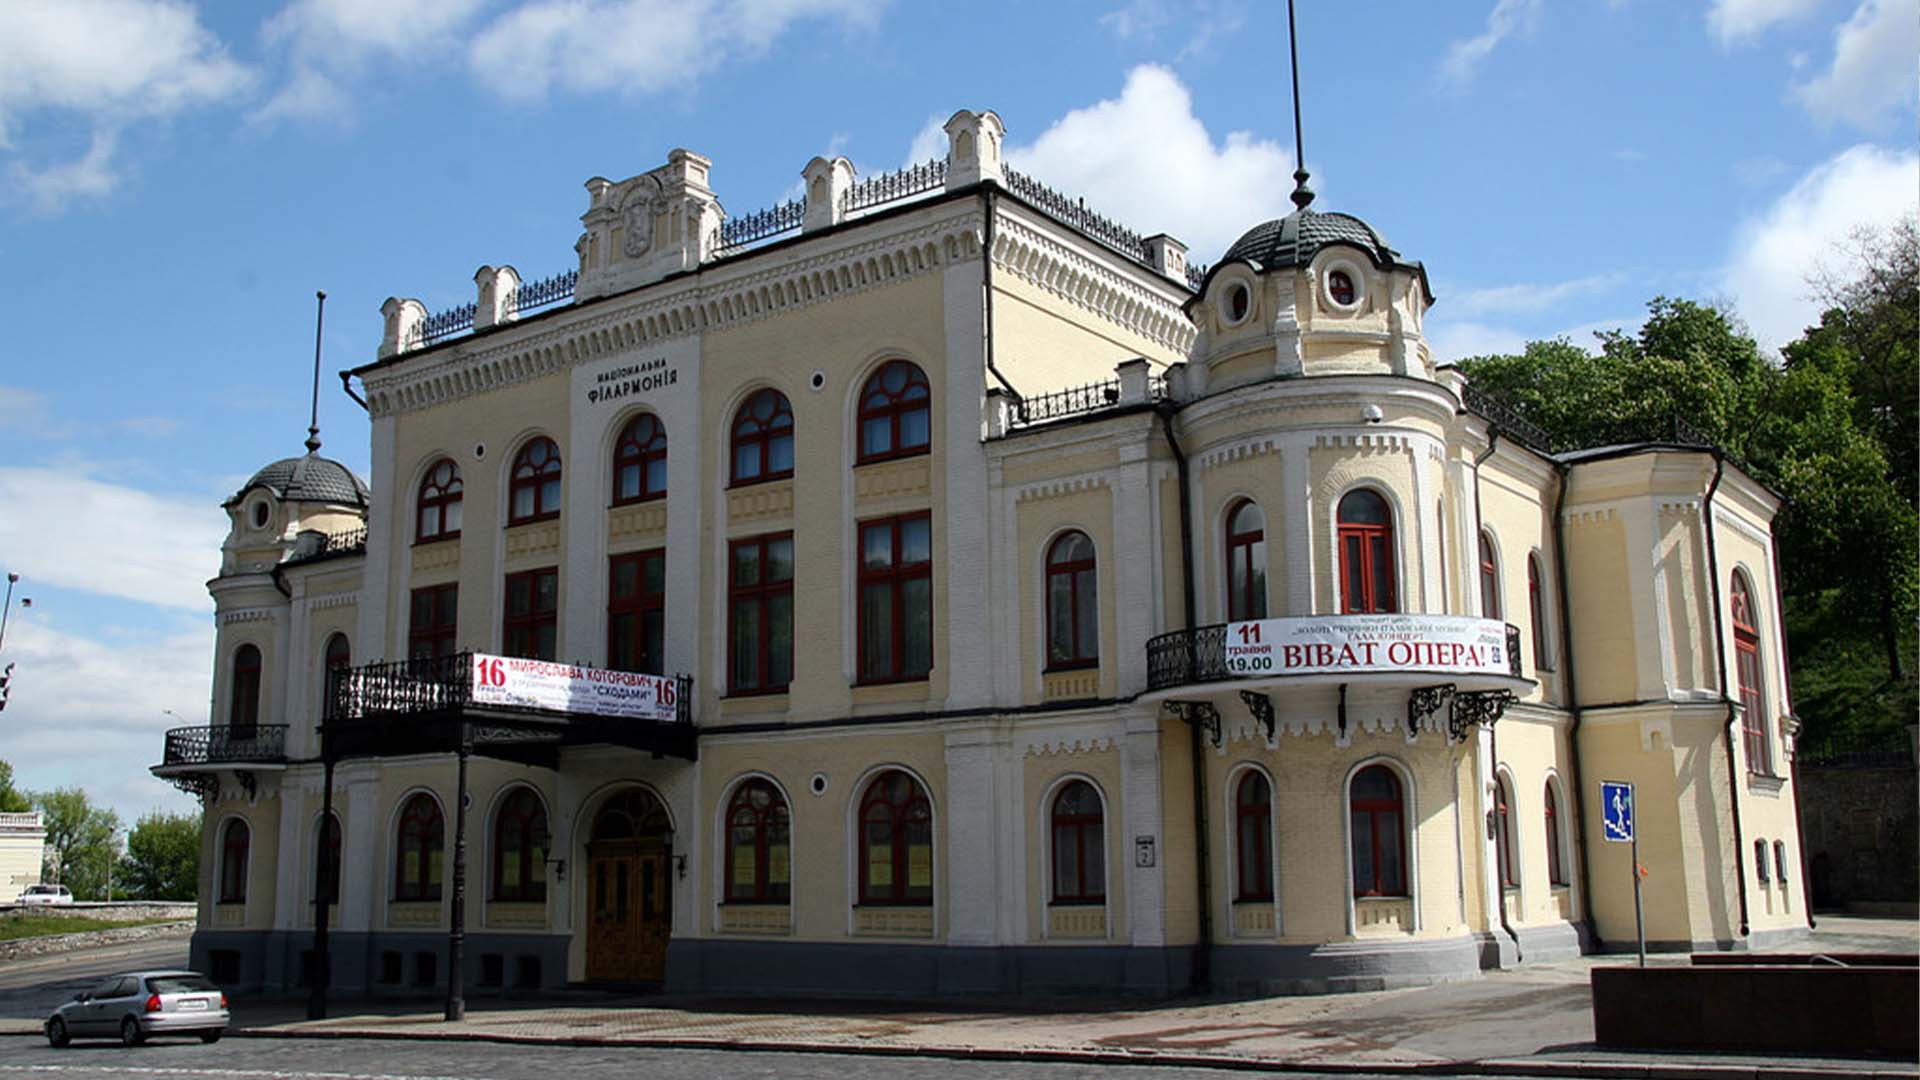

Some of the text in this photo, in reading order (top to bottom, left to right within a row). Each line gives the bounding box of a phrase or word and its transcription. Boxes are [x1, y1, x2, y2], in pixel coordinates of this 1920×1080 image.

[597, 358, 667, 383] НАЦІОНАЛЬНА
[587, 369, 678, 404] ФІЛАРМОНІЯ
[1238, 623, 1261, 644] 11
[1228, 645, 1272, 657] травня
[1228, 657, 1272, 671] 19.00
[1282, 641, 1486, 668] ВІВАТ ОПЕРА!
[478, 658, 506, 688] 16
[509, 661, 584, 680] МИРОСЛАВА
[587, 668, 653, 688] КОТОРОВИЧ
[655, 679, 676, 706] 16
